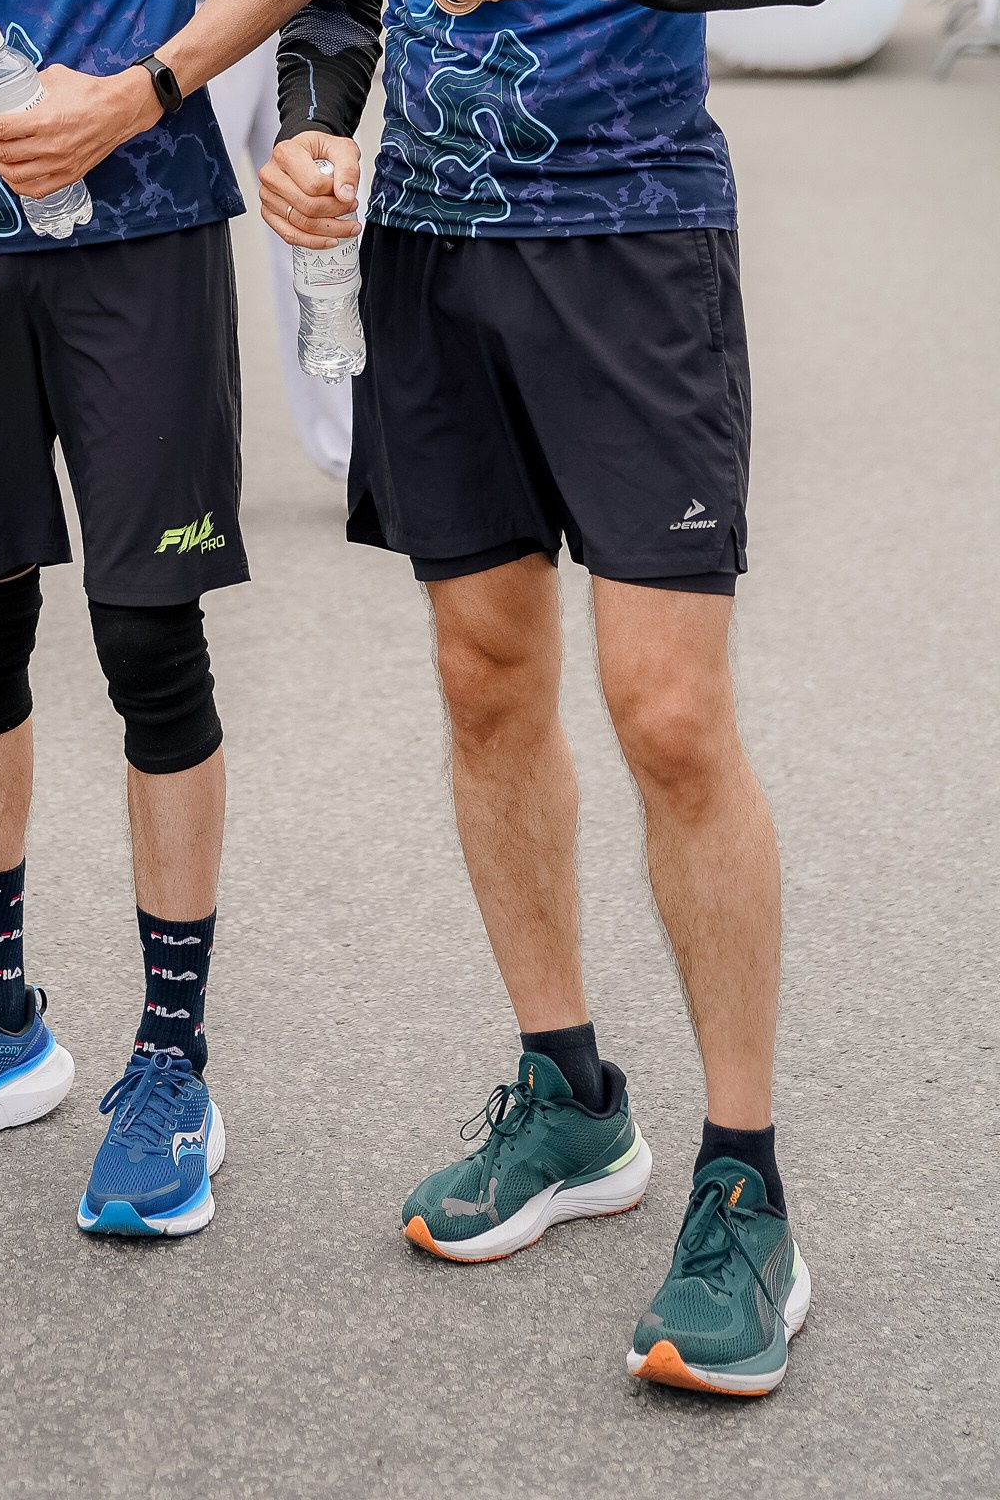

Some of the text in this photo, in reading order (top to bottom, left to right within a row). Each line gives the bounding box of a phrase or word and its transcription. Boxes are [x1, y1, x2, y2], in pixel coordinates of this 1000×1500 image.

[154, 511, 214, 555] FILA
[669, 520, 718, 530] DEMIX
[201, 534, 226, 554] PRO
[150, 931, 201, 946] FILA
[151, 965, 198, 981] FILA
[147, 1002, 190, 1019] FILA
[135, 1042, 184, 1058] FILA
